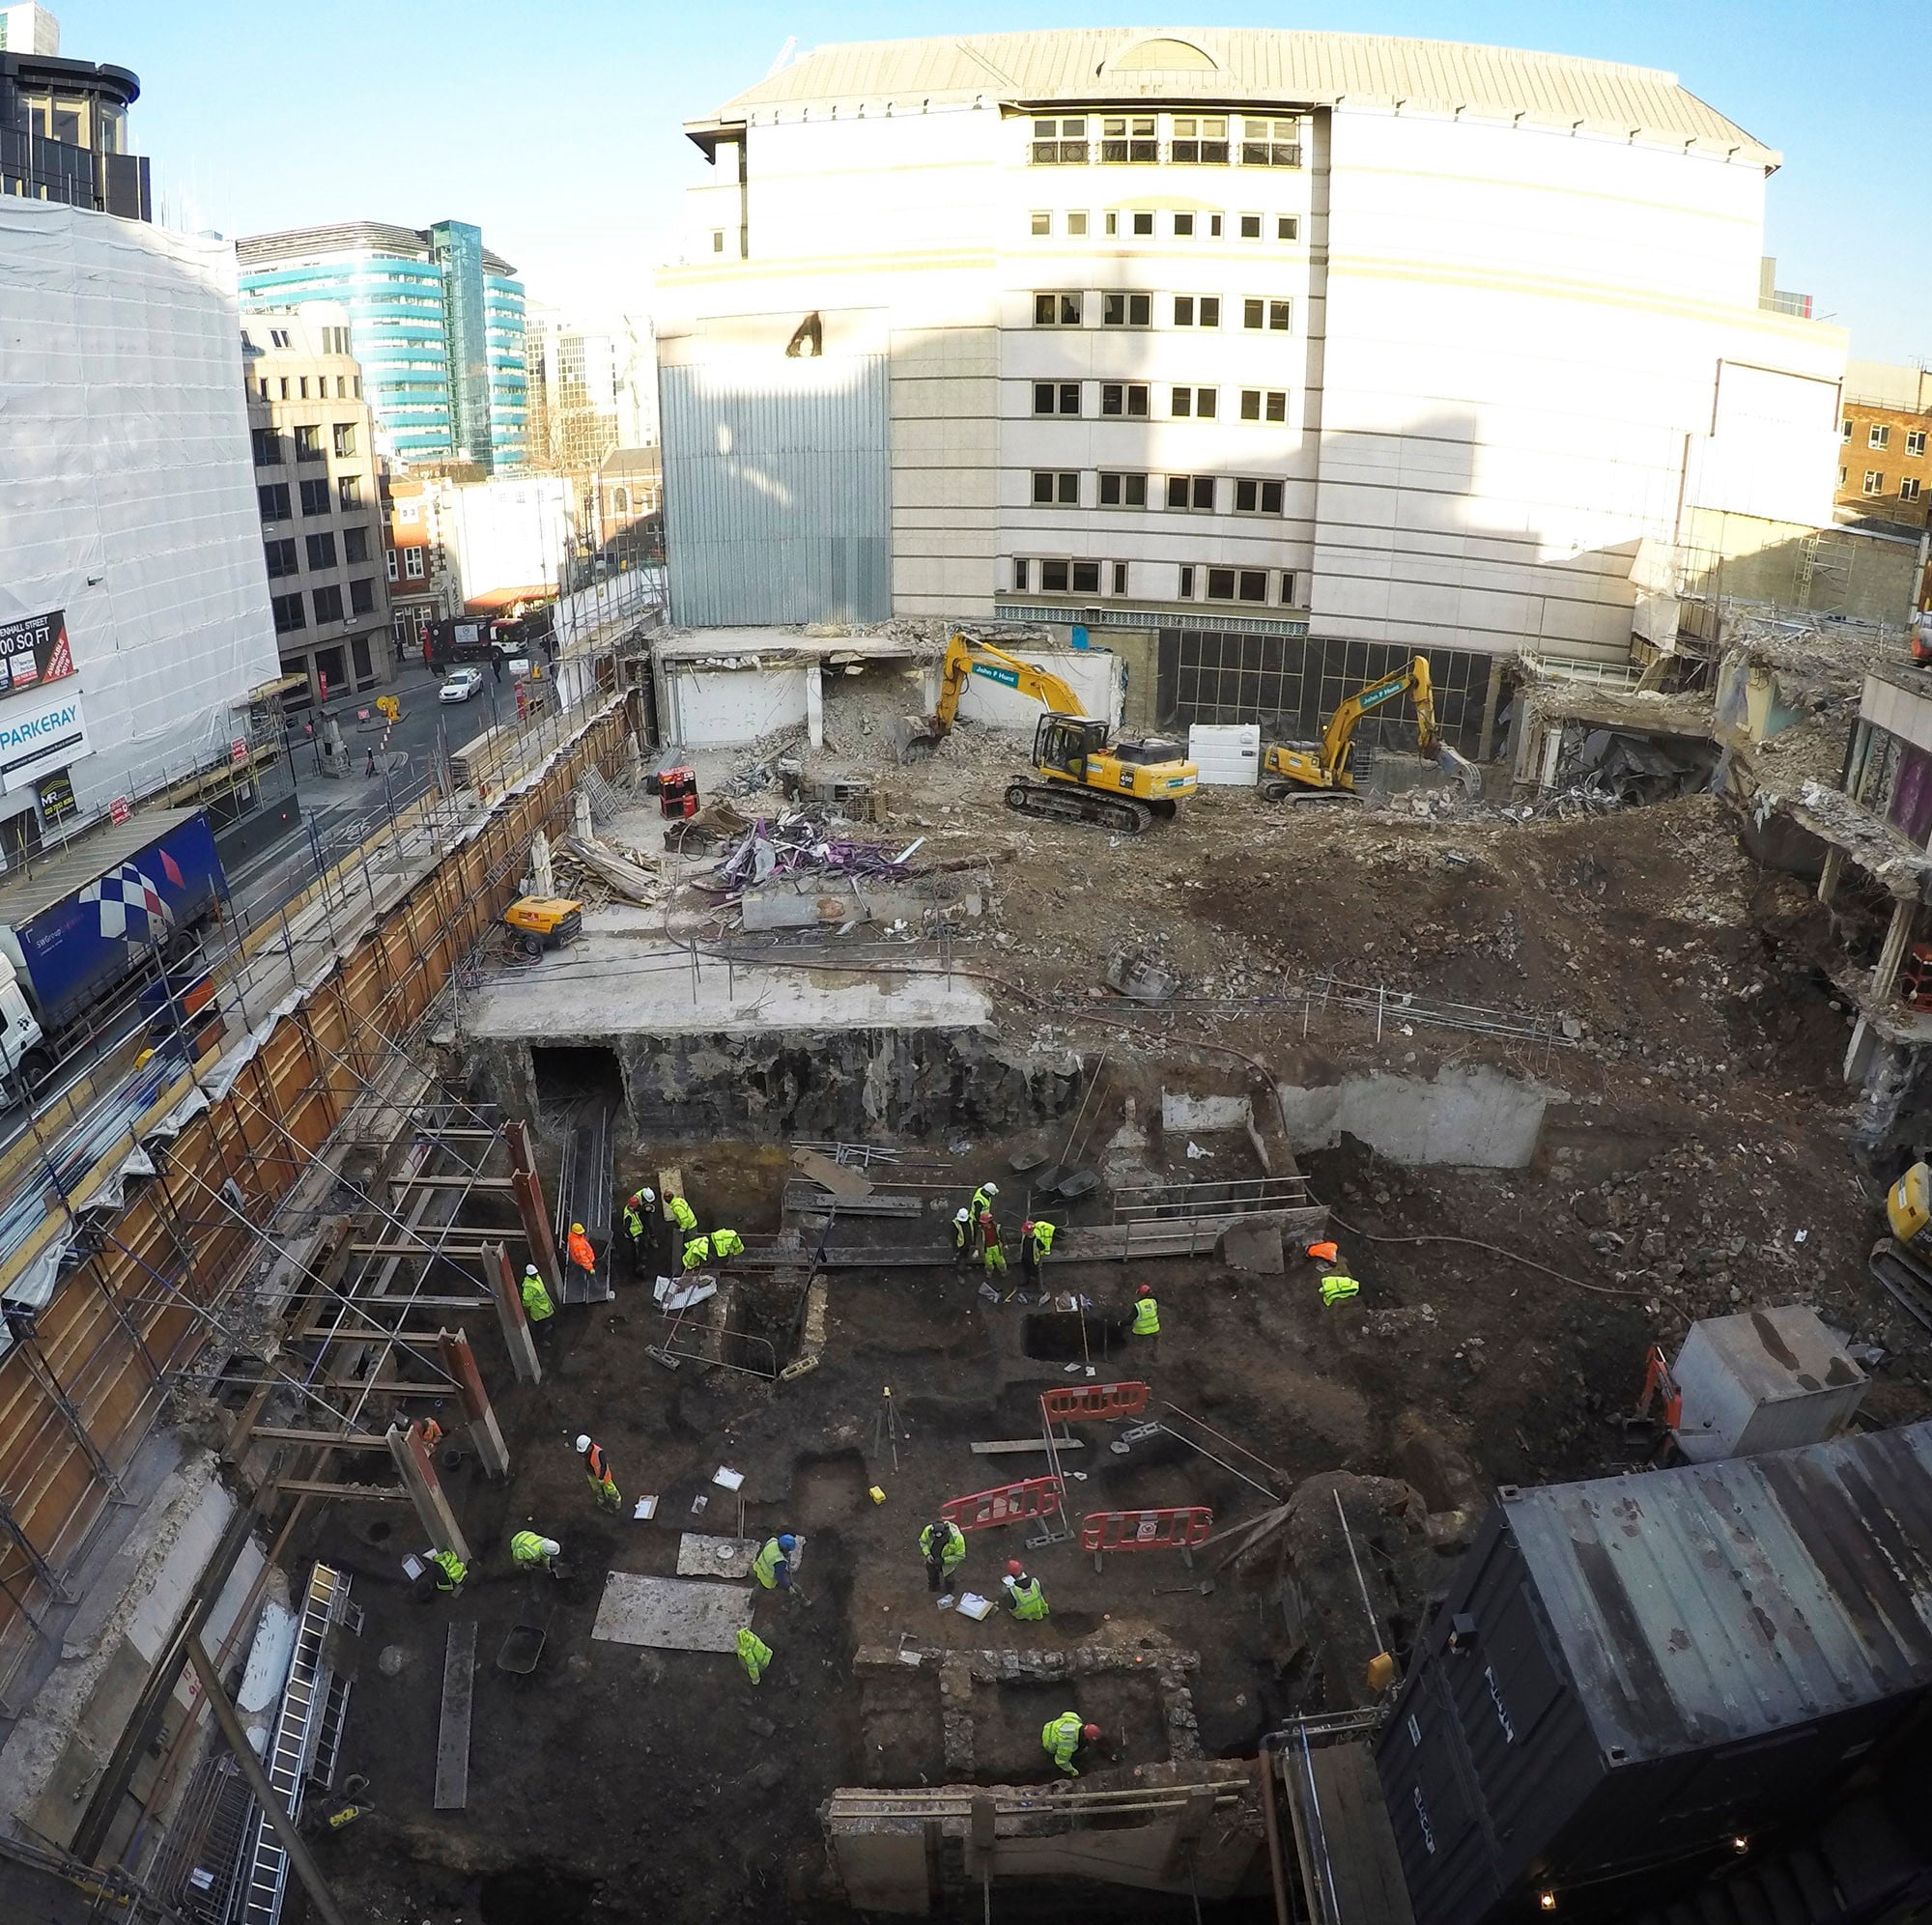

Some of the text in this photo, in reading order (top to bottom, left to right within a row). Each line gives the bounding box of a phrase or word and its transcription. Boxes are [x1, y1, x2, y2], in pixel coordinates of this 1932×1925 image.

[24, 616, 48, 631] STREET
[16, 632, 34, 650] SQ
[35, 626, 50, 644] FT
[46, 637, 65, 677] AVAILABLE
[977, 666, 992, 676] John
[0, 704, 76, 750] PARKERAY
[41, 792, 58, 807] MR
